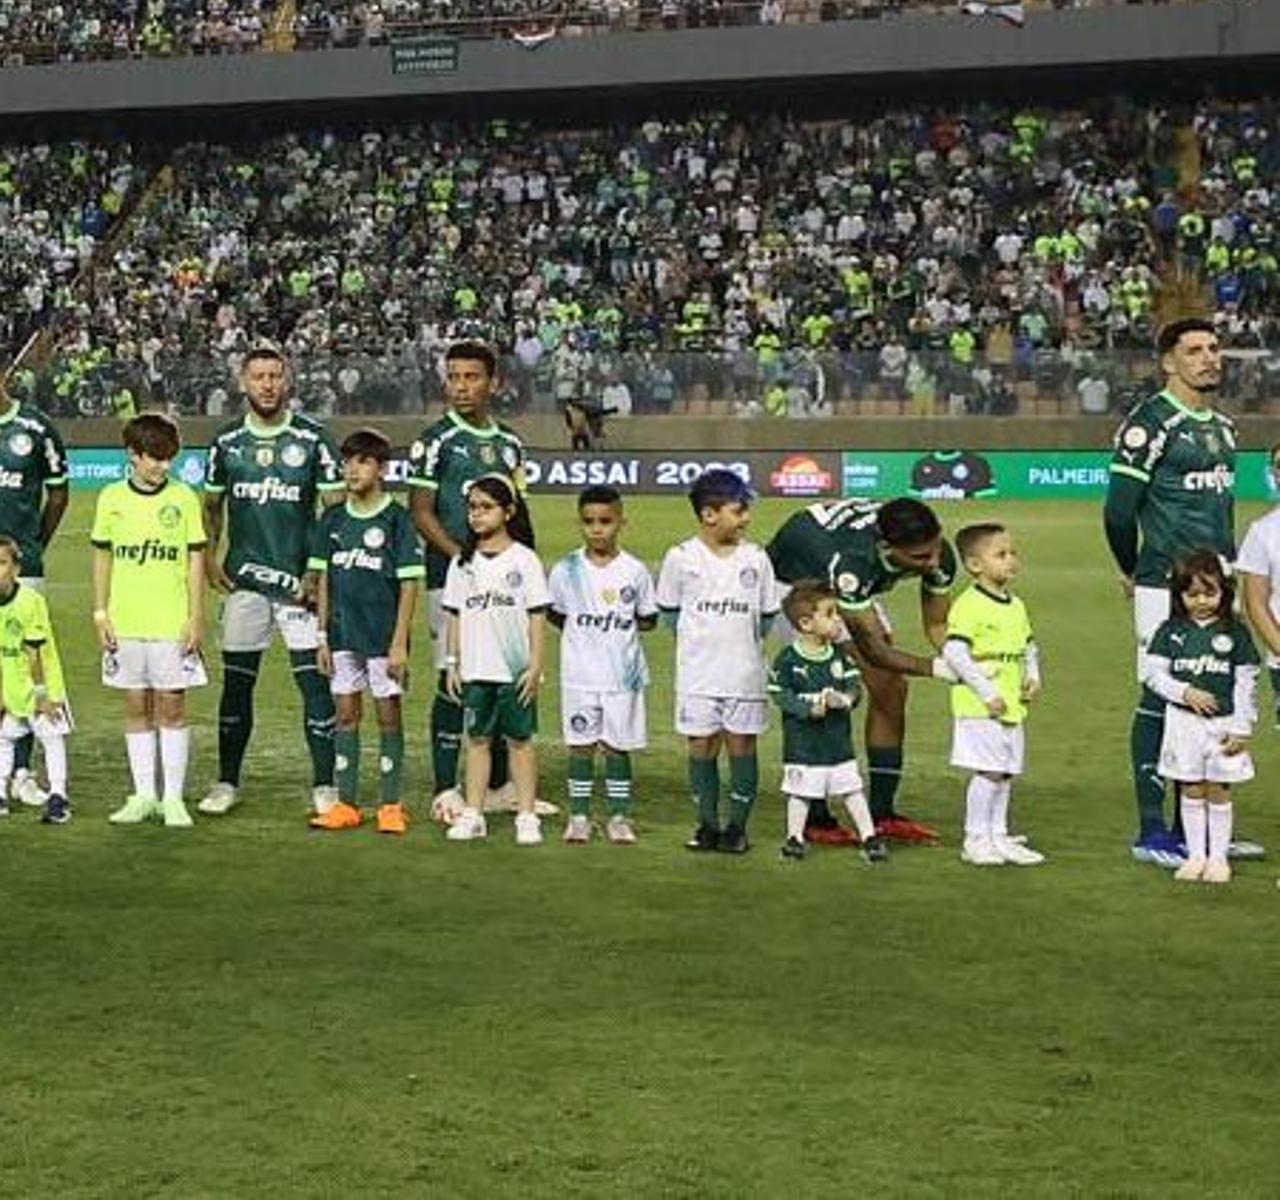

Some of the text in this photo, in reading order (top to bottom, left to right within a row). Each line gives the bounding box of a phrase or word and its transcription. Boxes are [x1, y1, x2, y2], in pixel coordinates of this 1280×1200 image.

[547, 460, 640, 485] ASSAÍ
[656, 462, 750, 485] 203
[233, 476, 301, 505] crefisa
